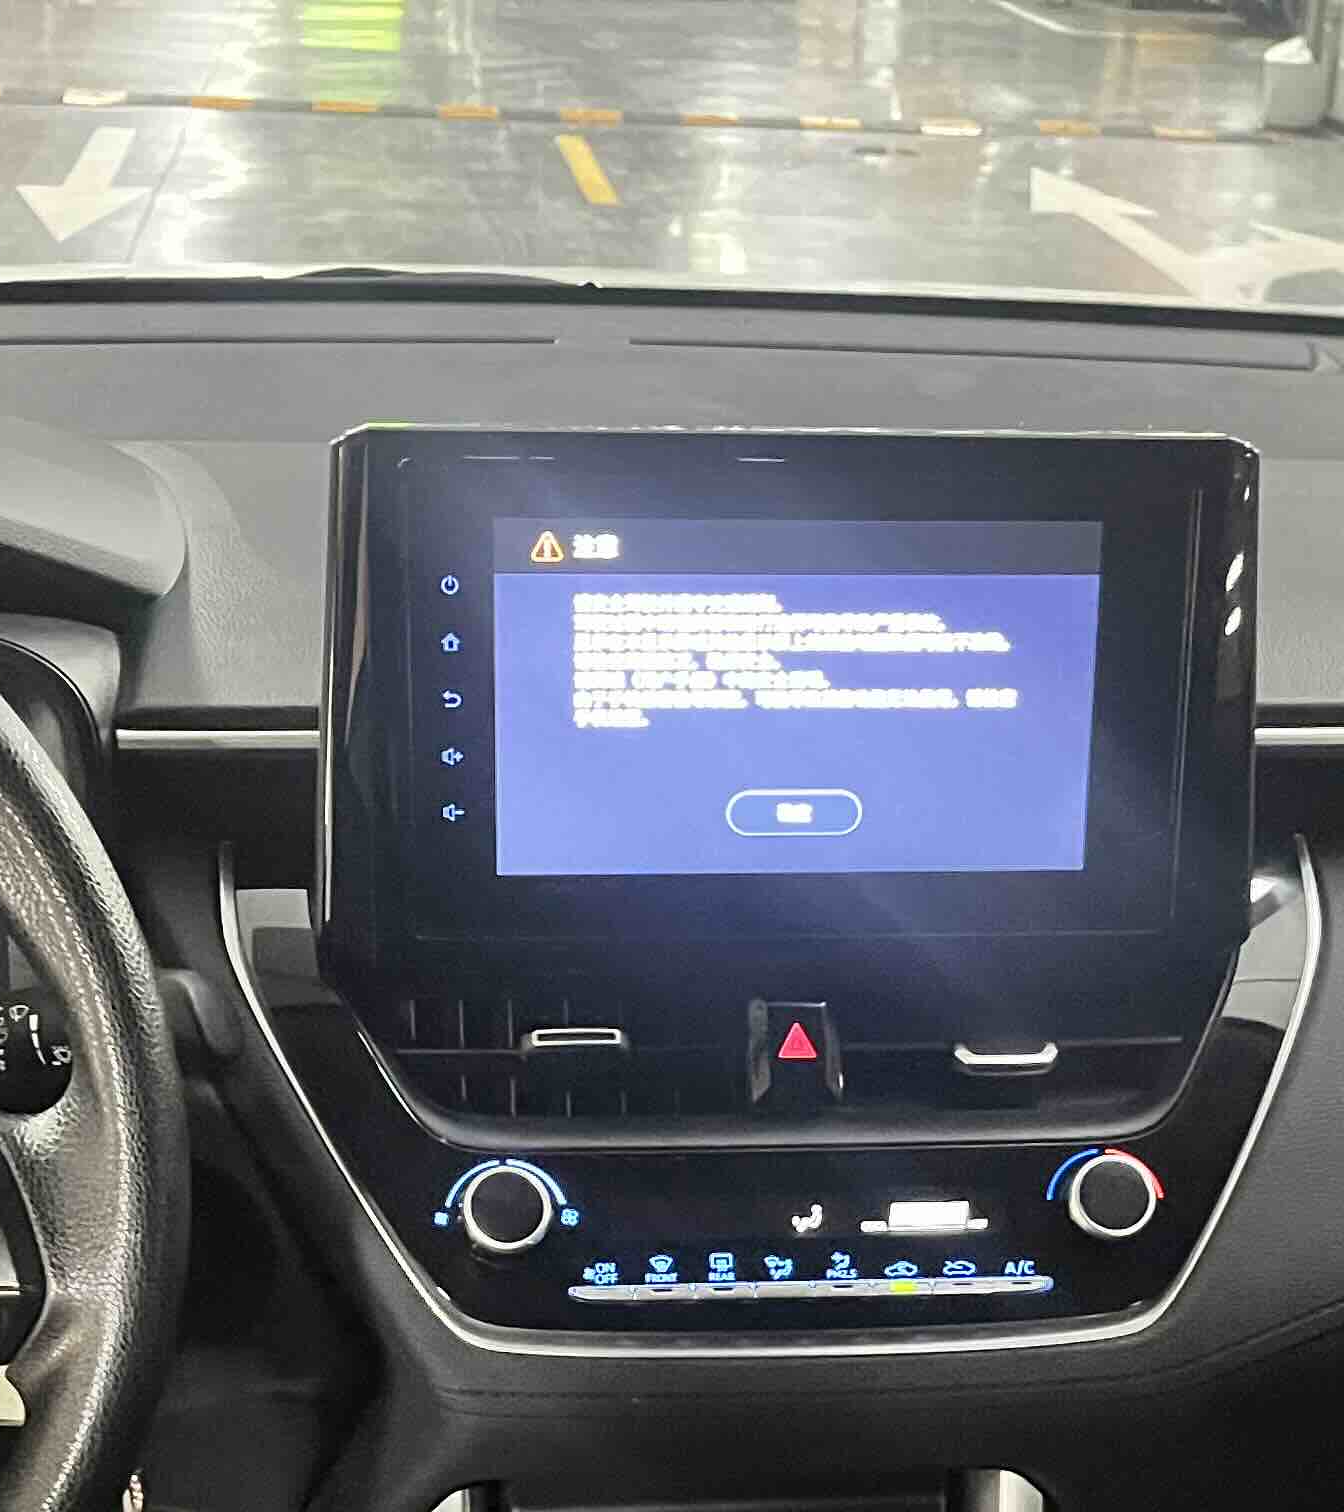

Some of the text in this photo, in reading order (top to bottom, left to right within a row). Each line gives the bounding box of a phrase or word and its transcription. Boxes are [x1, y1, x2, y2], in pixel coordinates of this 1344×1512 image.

[594, 1262, 615, 1273] ON
[1004, 1260, 1035, 1275] A/C
[594, 1273, 618, 1285] OFF
[644, 1272, 678, 1283] FRONT
[708, 1271, 736, 1282] REAR
